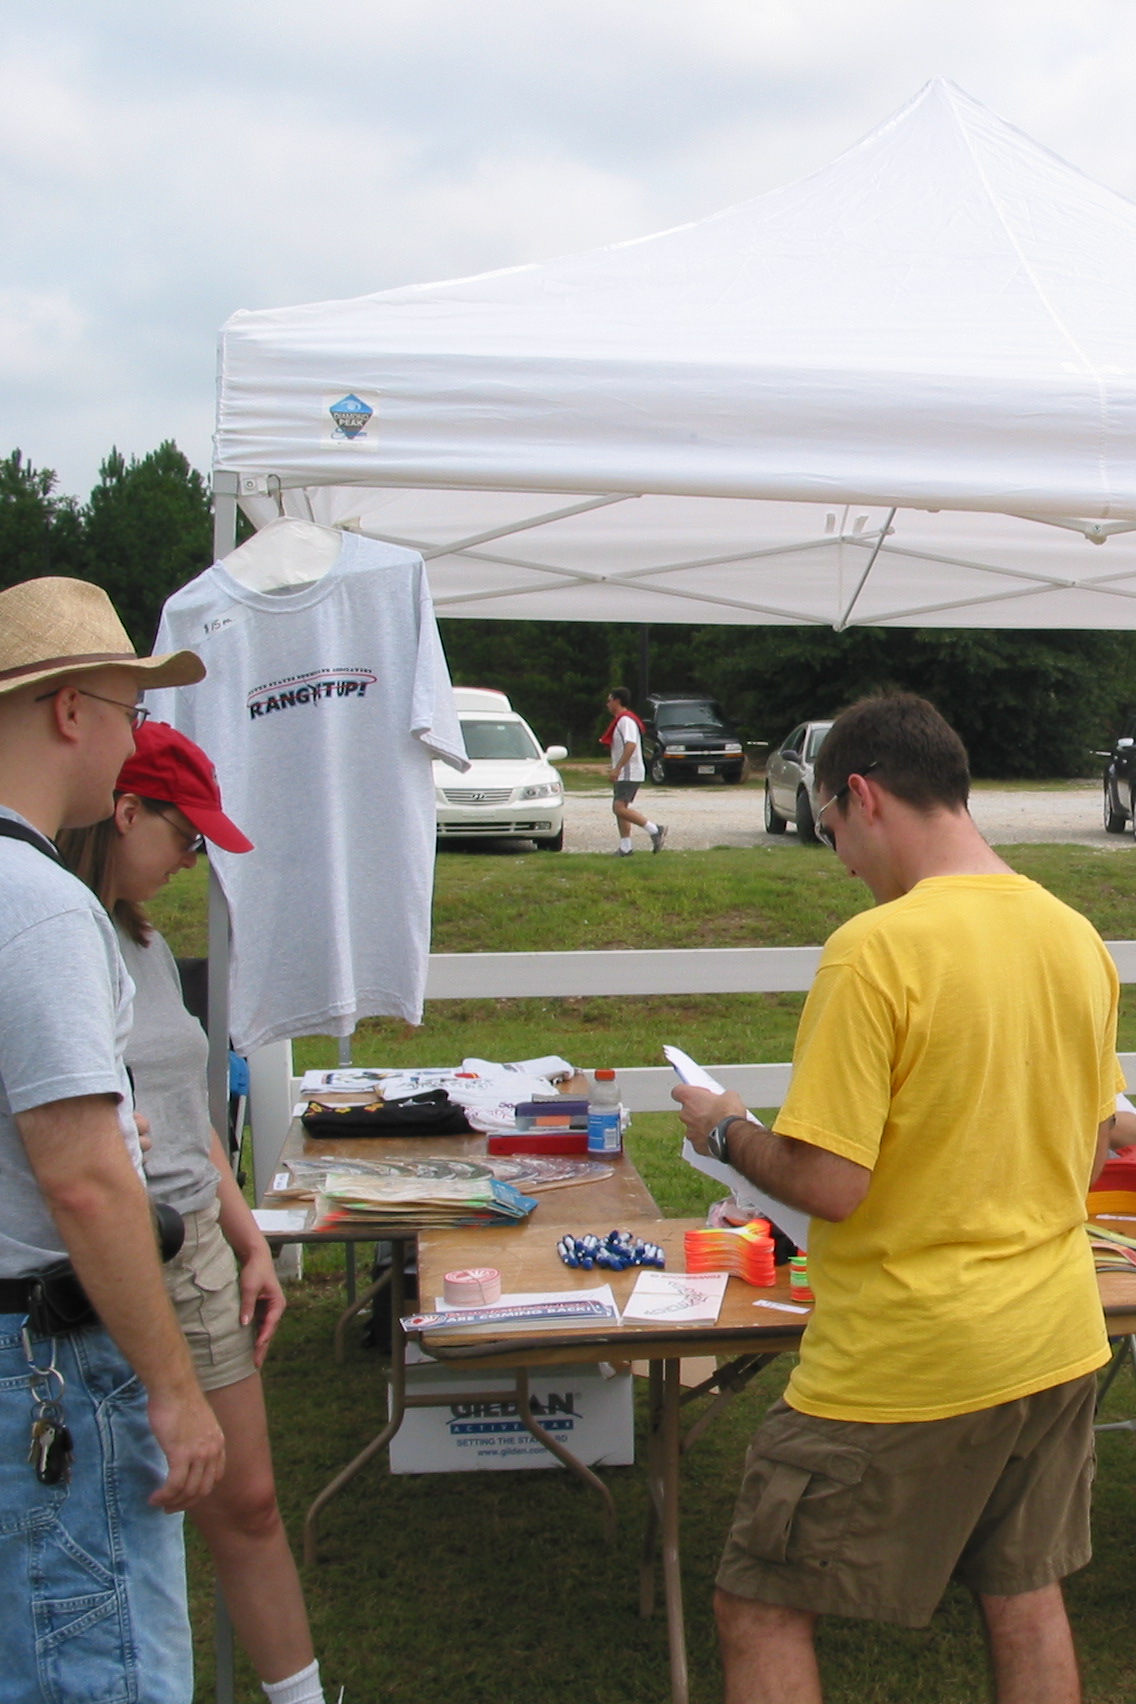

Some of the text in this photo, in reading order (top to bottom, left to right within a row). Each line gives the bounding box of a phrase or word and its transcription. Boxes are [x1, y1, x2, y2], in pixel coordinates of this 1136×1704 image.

[479, 1309, 543, 1319] COMING
[456, 1437, 496, 1448] SETTING
[498, 1436, 515, 1446] THE
